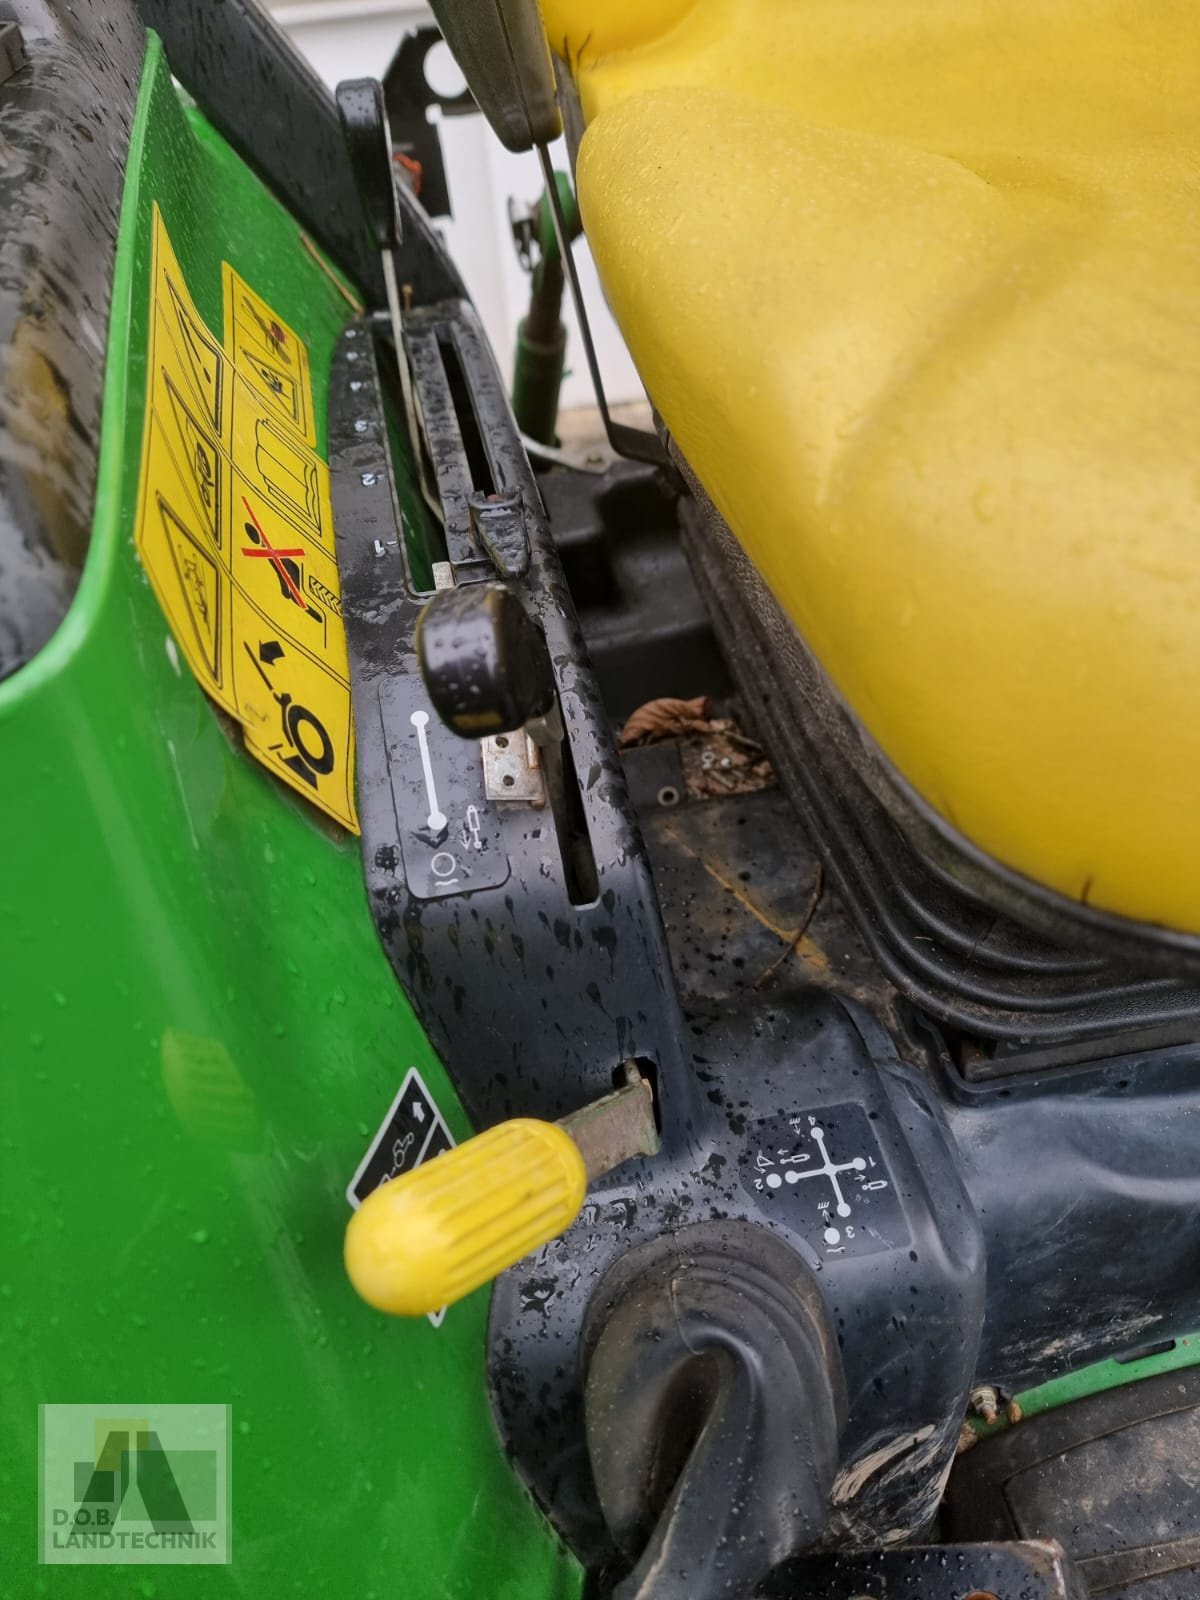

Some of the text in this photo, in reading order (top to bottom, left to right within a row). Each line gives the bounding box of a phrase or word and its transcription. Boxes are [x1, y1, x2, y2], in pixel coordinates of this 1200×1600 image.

[361, 473, 376, 486] 2
[373, 539, 386, 554] 1
[808, 1116, 816, 1126] 4
[868, 1156, 876, 1167] 1
[753, 1178, 763, 1190] 2
[845, 1226, 855, 1238] 3
